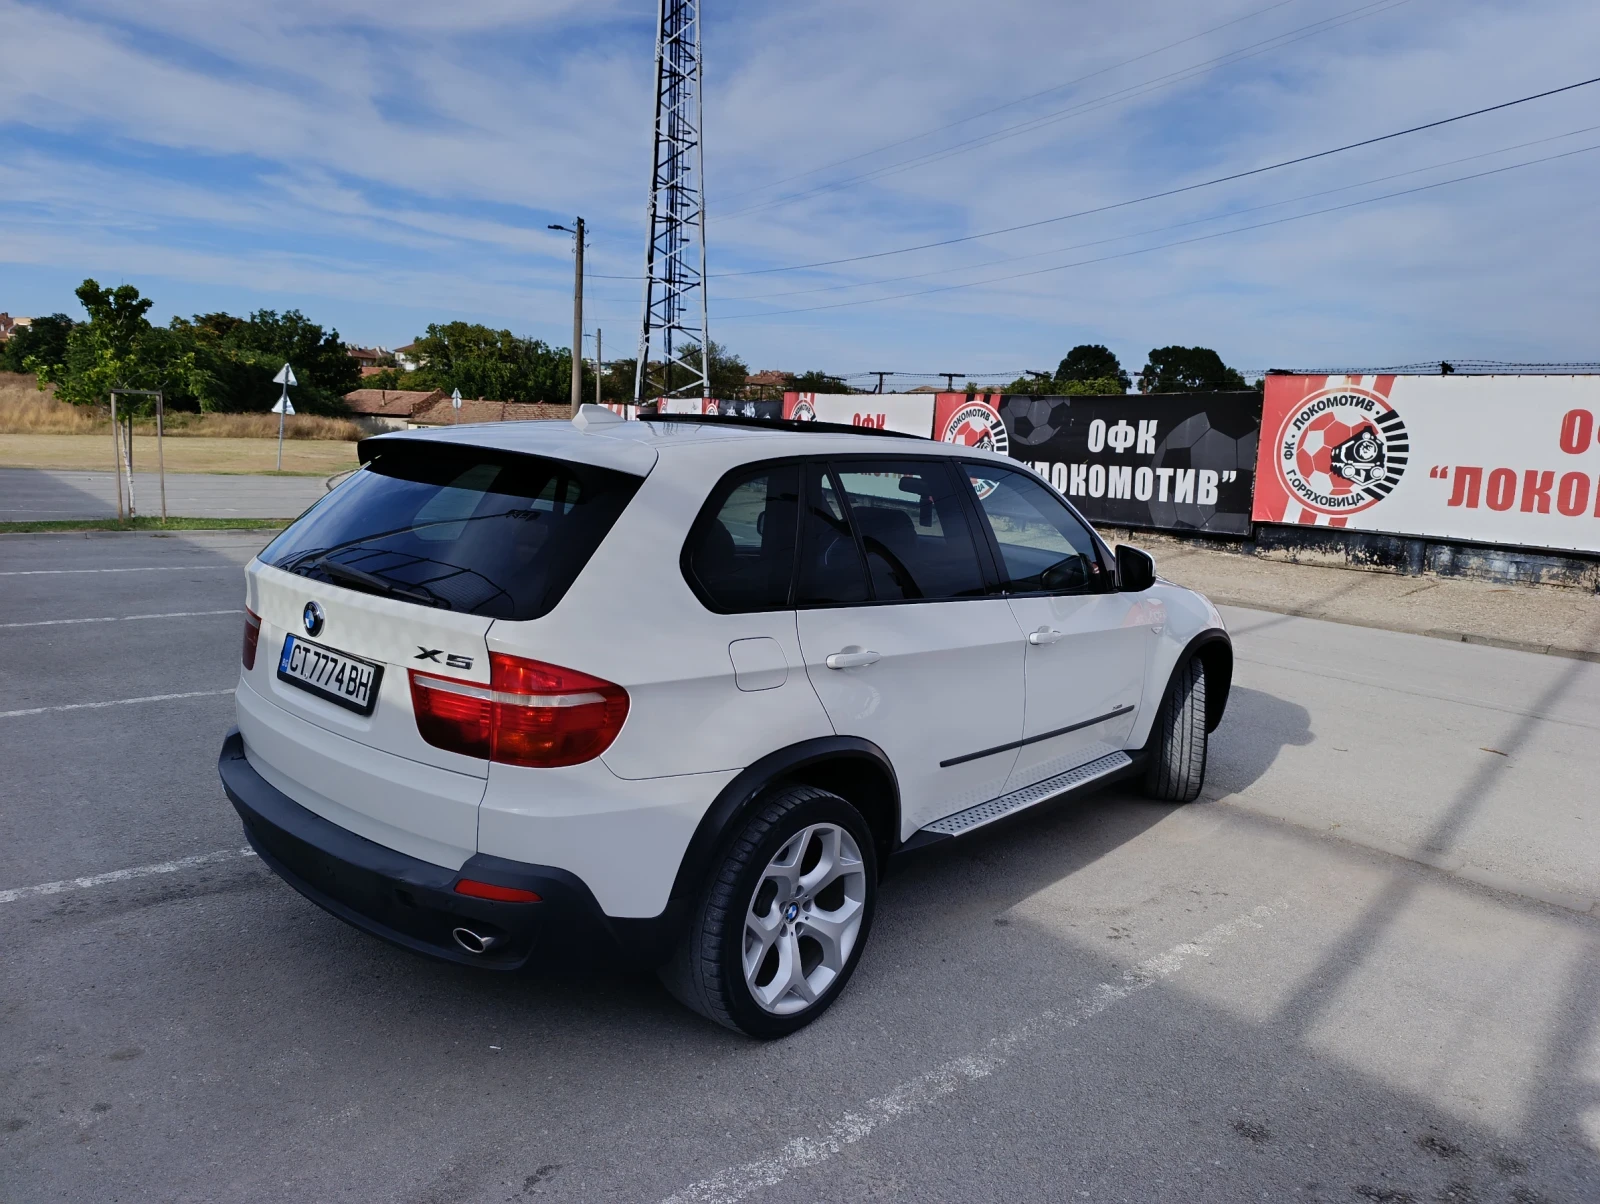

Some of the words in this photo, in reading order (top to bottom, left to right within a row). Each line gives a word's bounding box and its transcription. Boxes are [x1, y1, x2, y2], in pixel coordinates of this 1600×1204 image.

[949, 408, 991, 435] ЛОКОМОТИВ
[1293, 395, 1375, 431] ЛОКОМОТИВ
[1087, 419, 1158, 454] ОФК
[1559, 409, 1600, 454] О
[1284, 441, 1295, 460] ФК
[1429, 465, 1600, 518] “ЛОКО
[413, 645, 474, 670] X5
